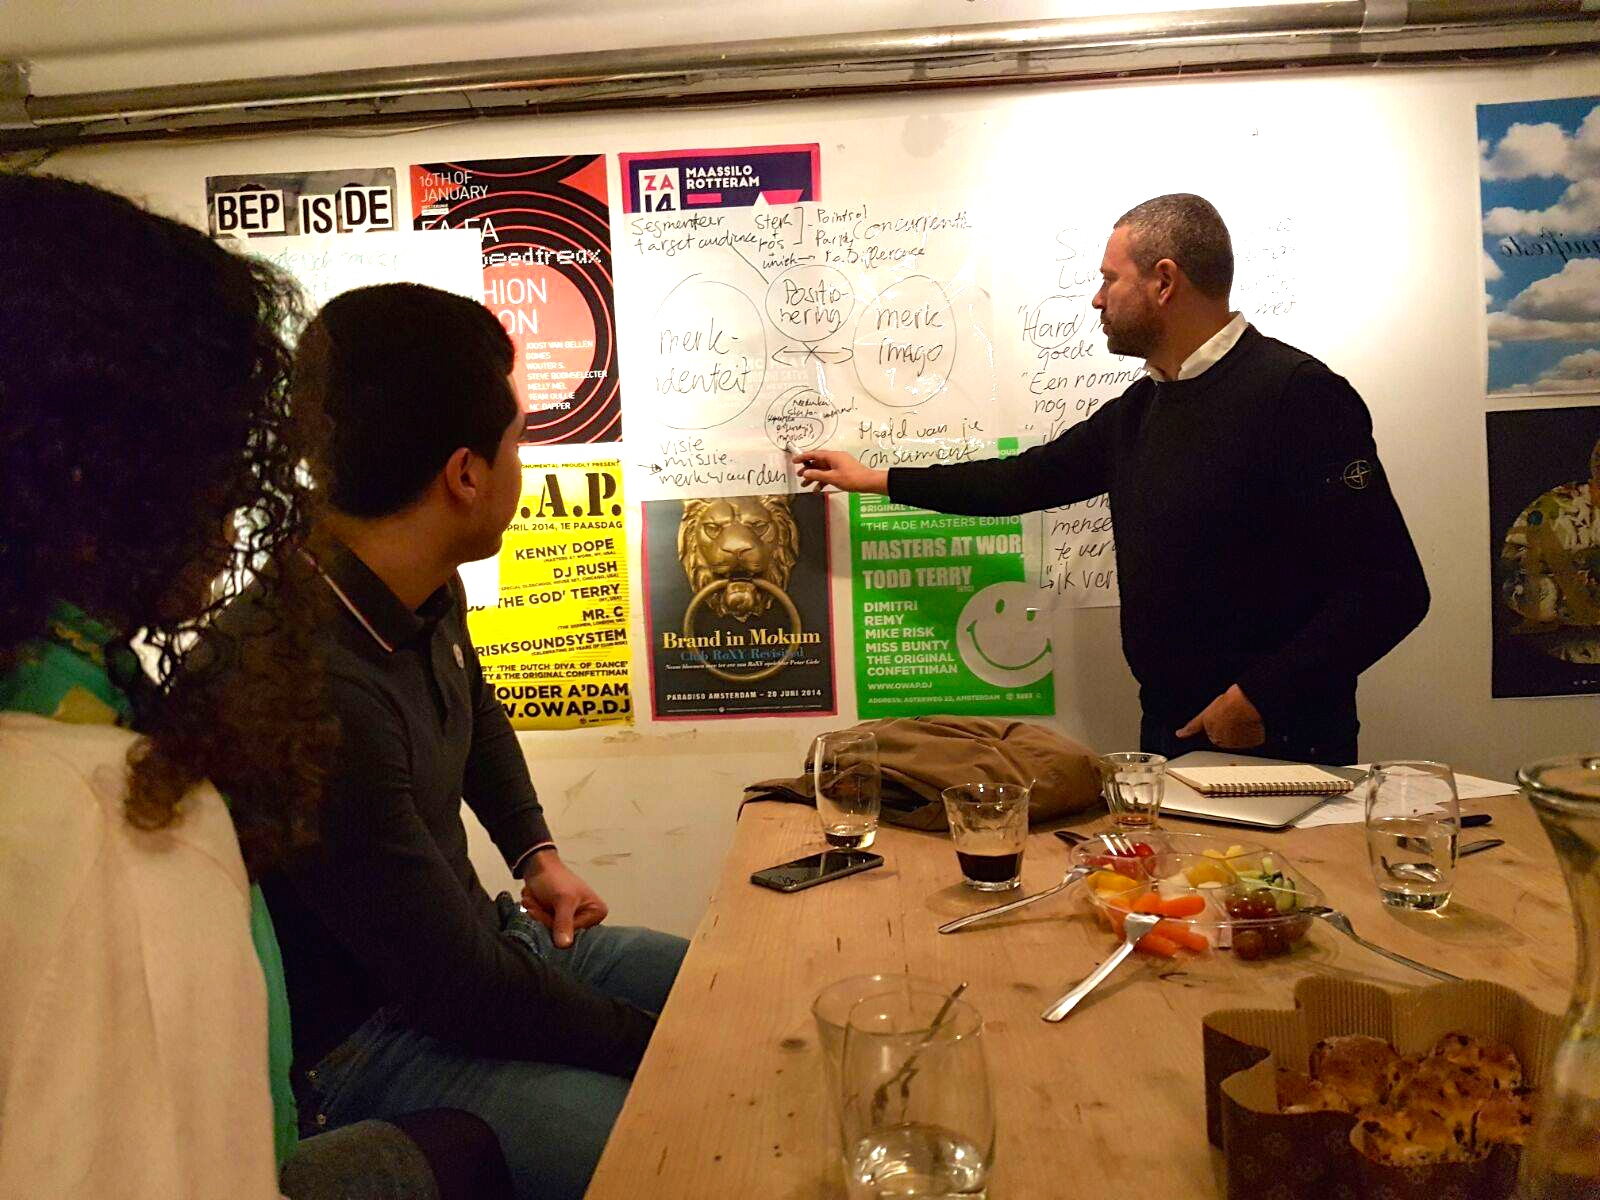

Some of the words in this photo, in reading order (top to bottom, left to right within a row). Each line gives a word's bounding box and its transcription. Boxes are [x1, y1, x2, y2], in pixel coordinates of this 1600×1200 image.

[419, 173, 450, 187] 16TH
[453, 170, 473, 185] OF
[686, 165, 752, 179] MAASSILO
[644, 174, 674, 191] ZA
[686, 176, 760, 190] ROTTERAM
[421, 185, 488, 202] JANUARY
[217, 193, 280, 230] BEP
[303, 197, 332, 234] IS
[345, 190, 389, 225] DE
[1037, 340, 1094, 371] goede
[542, 401, 572, 410] DAPPER
[1033, 398, 1066, 421] nog
[1075, 397, 1099, 417] op
[916, 425, 948, 438] van
[660, 436, 704, 455] visie
[505, 523, 528, 531] PRIL
[573, 521, 623, 530] PAASDAG
[892, 520, 917, 530] ADE
[920, 517, 976, 529] MASTERS
[979, 515, 1022, 526] EDITIO
[516, 544, 567, 561] KENNY
[572, 538, 614, 554] DOPE
[861, 537, 946, 561] MASTERS
[951, 536, 973, 557] AT
[975, 533, 1023, 555] WOR
[1054, 541, 1072, 561] te
[553, 566, 572, 579] DJ
[576, 561, 618, 577] RUSH
[862, 568, 912, 590] TODD
[915, 565, 972, 587] TERRY
[570, 583, 621, 600] TERRY
[582, 608, 609, 622] MR.
[613, 606, 624, 617] C
[864, 600, 918, 613] DIMITRI
[864, 614, 904, 626] REMY
[662, 629, 722, 649] Brand
[726, 630, 744, 647] in
[750, 627, 821, 646] Mokum
[865, 627, 899, 639] MIKE
[903, 626, 935, 638] RISK
[476, 628, 627, 657] RISKSOUNDSYSTEM
[866, 641, 898, 653] MISS
[901, 640, 950, 651] BUNTY
[713, 649, 746, 661] RoXY
[867, 655, 891, 665] THE
[894, 653, 955, 664] ORIGINAL
[503, 671, 521, 680] THE
[522, 670, 564, 679] ORIGINAL
[565, 668, 629, 678] CONFETTIMAN
[520, 663, 551, 671] DUTCH
[554, 662, 575, 670] DIVA
[580, 661, 592, 669] OF
[867, 664, 958, 677] CONFETTIMAN
[496, 684, 562, 700] OUDER
[568, 683, 629, 698] A'DAM
[666, 692, 706, 701] PARADISO
[708, 691, 757, 700] AMSTERDAM
[801, 688, 822, 697] 2014
